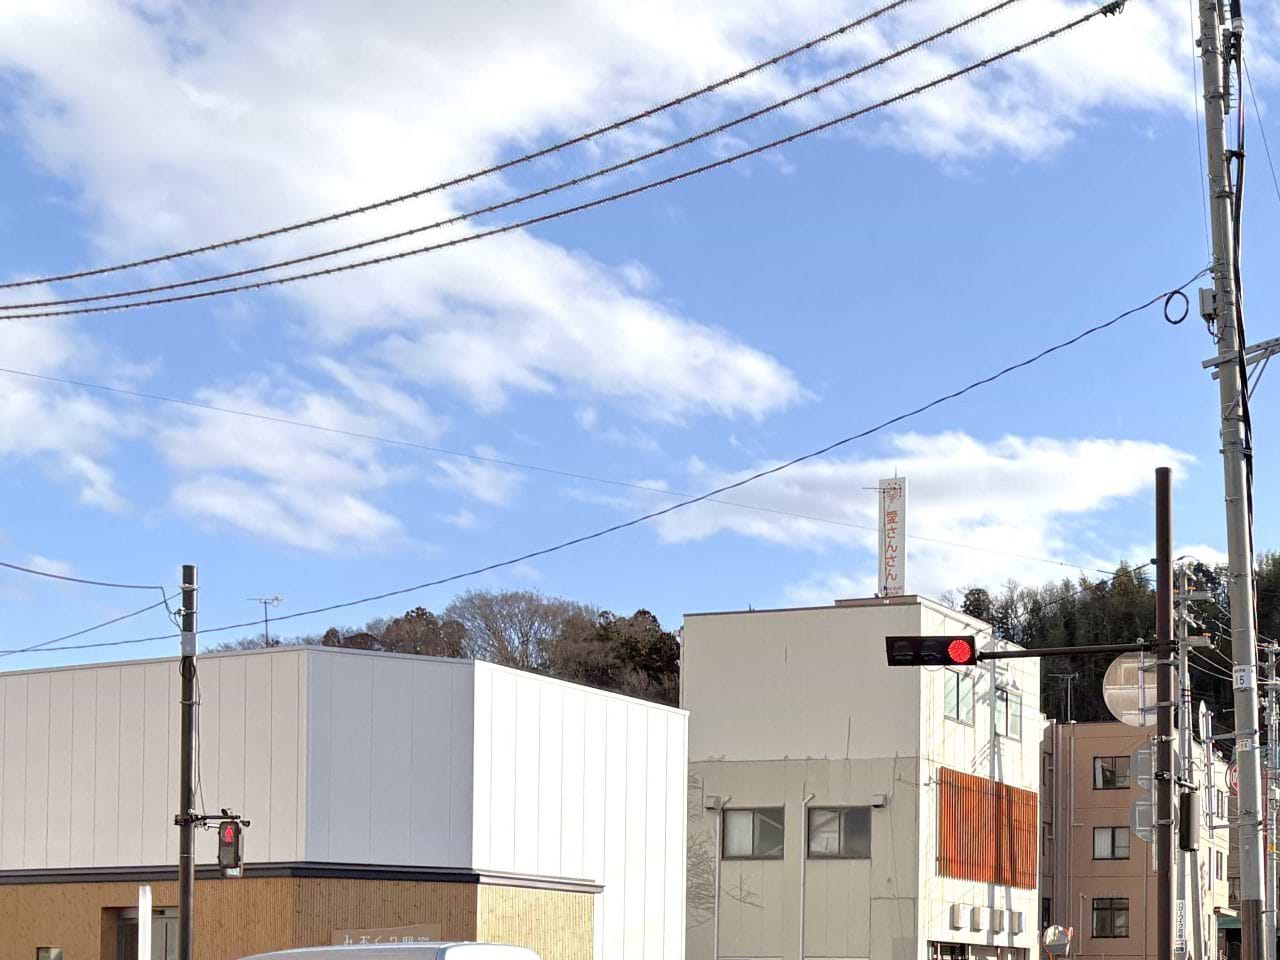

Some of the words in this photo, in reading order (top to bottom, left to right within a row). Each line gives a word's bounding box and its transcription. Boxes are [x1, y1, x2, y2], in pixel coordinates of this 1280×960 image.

[886, 510, 898, 582] 愛さんさん
